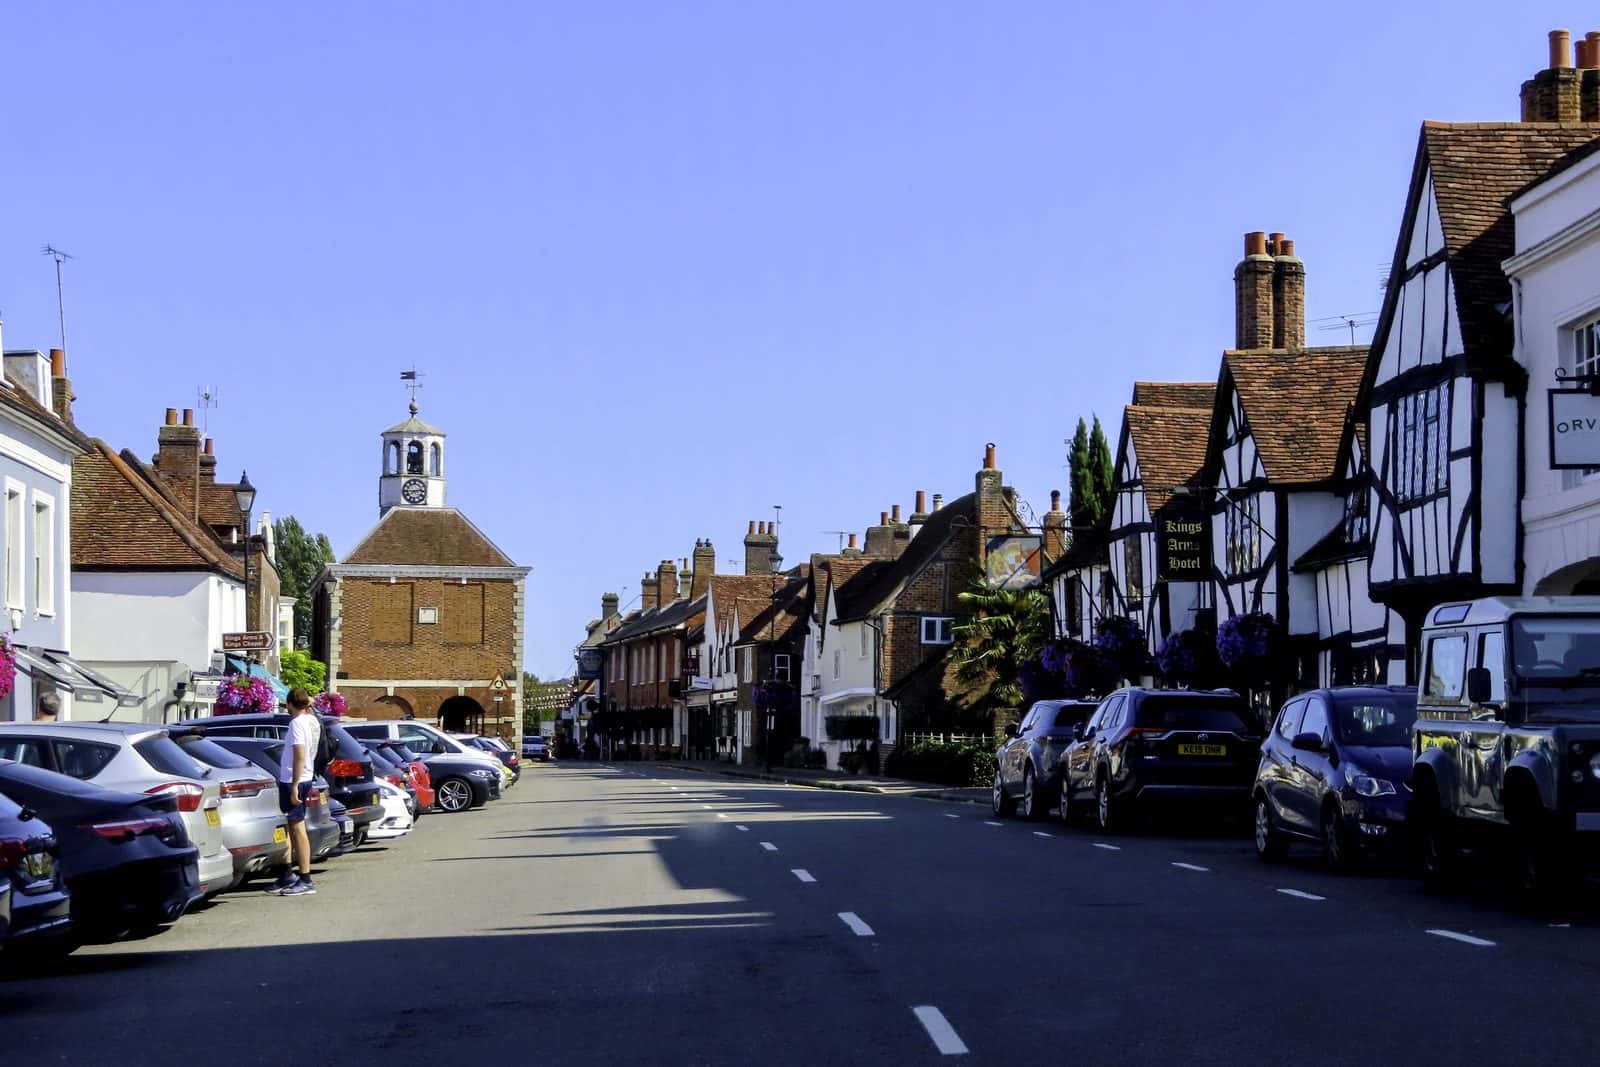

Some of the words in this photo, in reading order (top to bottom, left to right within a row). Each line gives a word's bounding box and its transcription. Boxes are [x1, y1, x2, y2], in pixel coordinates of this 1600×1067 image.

[1557, 418, 1600, 433] ORV
[1165, 518, 1202, 534] Kings
[1168, 538, 1200, 551] Arms
[1168, 556, 1200, 571] Hotel
